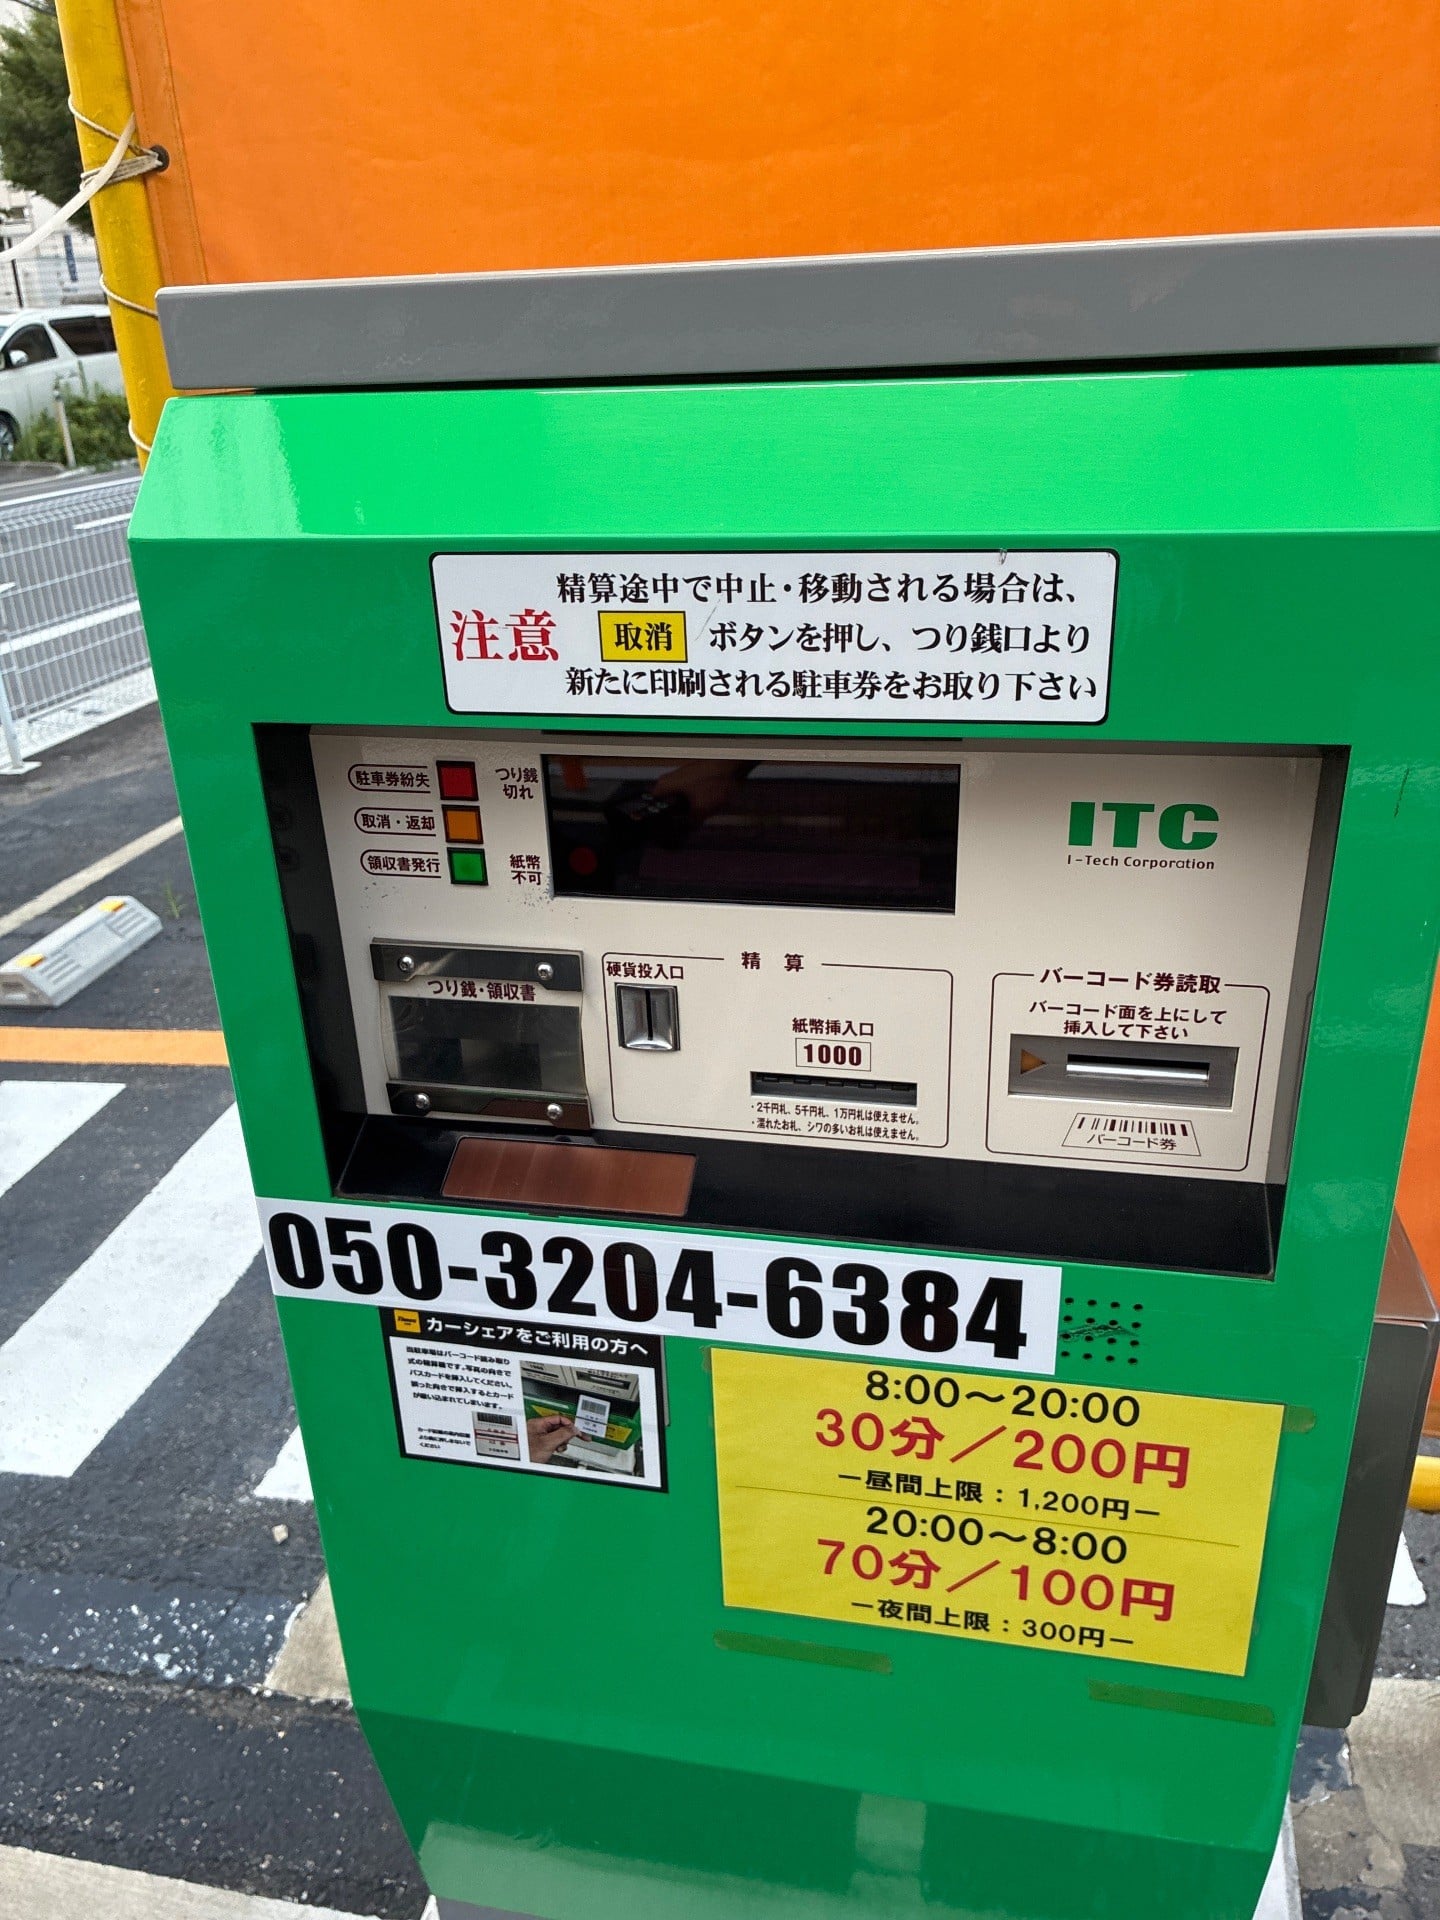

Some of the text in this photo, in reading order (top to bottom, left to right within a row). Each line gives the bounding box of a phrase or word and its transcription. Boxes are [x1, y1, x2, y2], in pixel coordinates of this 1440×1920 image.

[556, 572, 1079, 604] 精算途中で中止・移動される場合は、
[449, 609, 559, 662] 注意
[613, 621, 674, 653] 取消
[709, 620, 1091, 654] ボタンを押し、つり銭口より
[565, 667, 1098, 701] 新たに印刷される駐車券をお取り下さい
[355, 770, 430, 788] 駐車券紛失
[495, 767, 539, 783] つり銭
[503, 784, 534, 800] 切れ
[361, 813, 435, 831] 取消・返却
[1068, 801, 1220, 850] ITC
[367, 855, 440, 873] 領収書発行
[509, 854, 541, 870] 紙幣
[1123, 856, 1215, 870] Corporation
[511, 870, 542, 886] 不可
[606, 961, 684, 980] 硬貨投入口
[1040, 967, 1221, 994] バーコード券読取
[427, 979, 536, 1002] つり銭・領収書
[1029, 1000, 1227, 1025] バーコード面を上にして
[792, 1017, 874, 1037] 紙幣挿入口
[1063, 1020, 1188, 1040] 挿入して下さい
[803, 1043, 862, 1066] 1000
[1087, 1134, 1177, 1151] バーコード券
[268, 1211, 1028, 1360] 050-3204-6384
[426, 1317, 649, 1356] カーシェアをご利用の方へ
